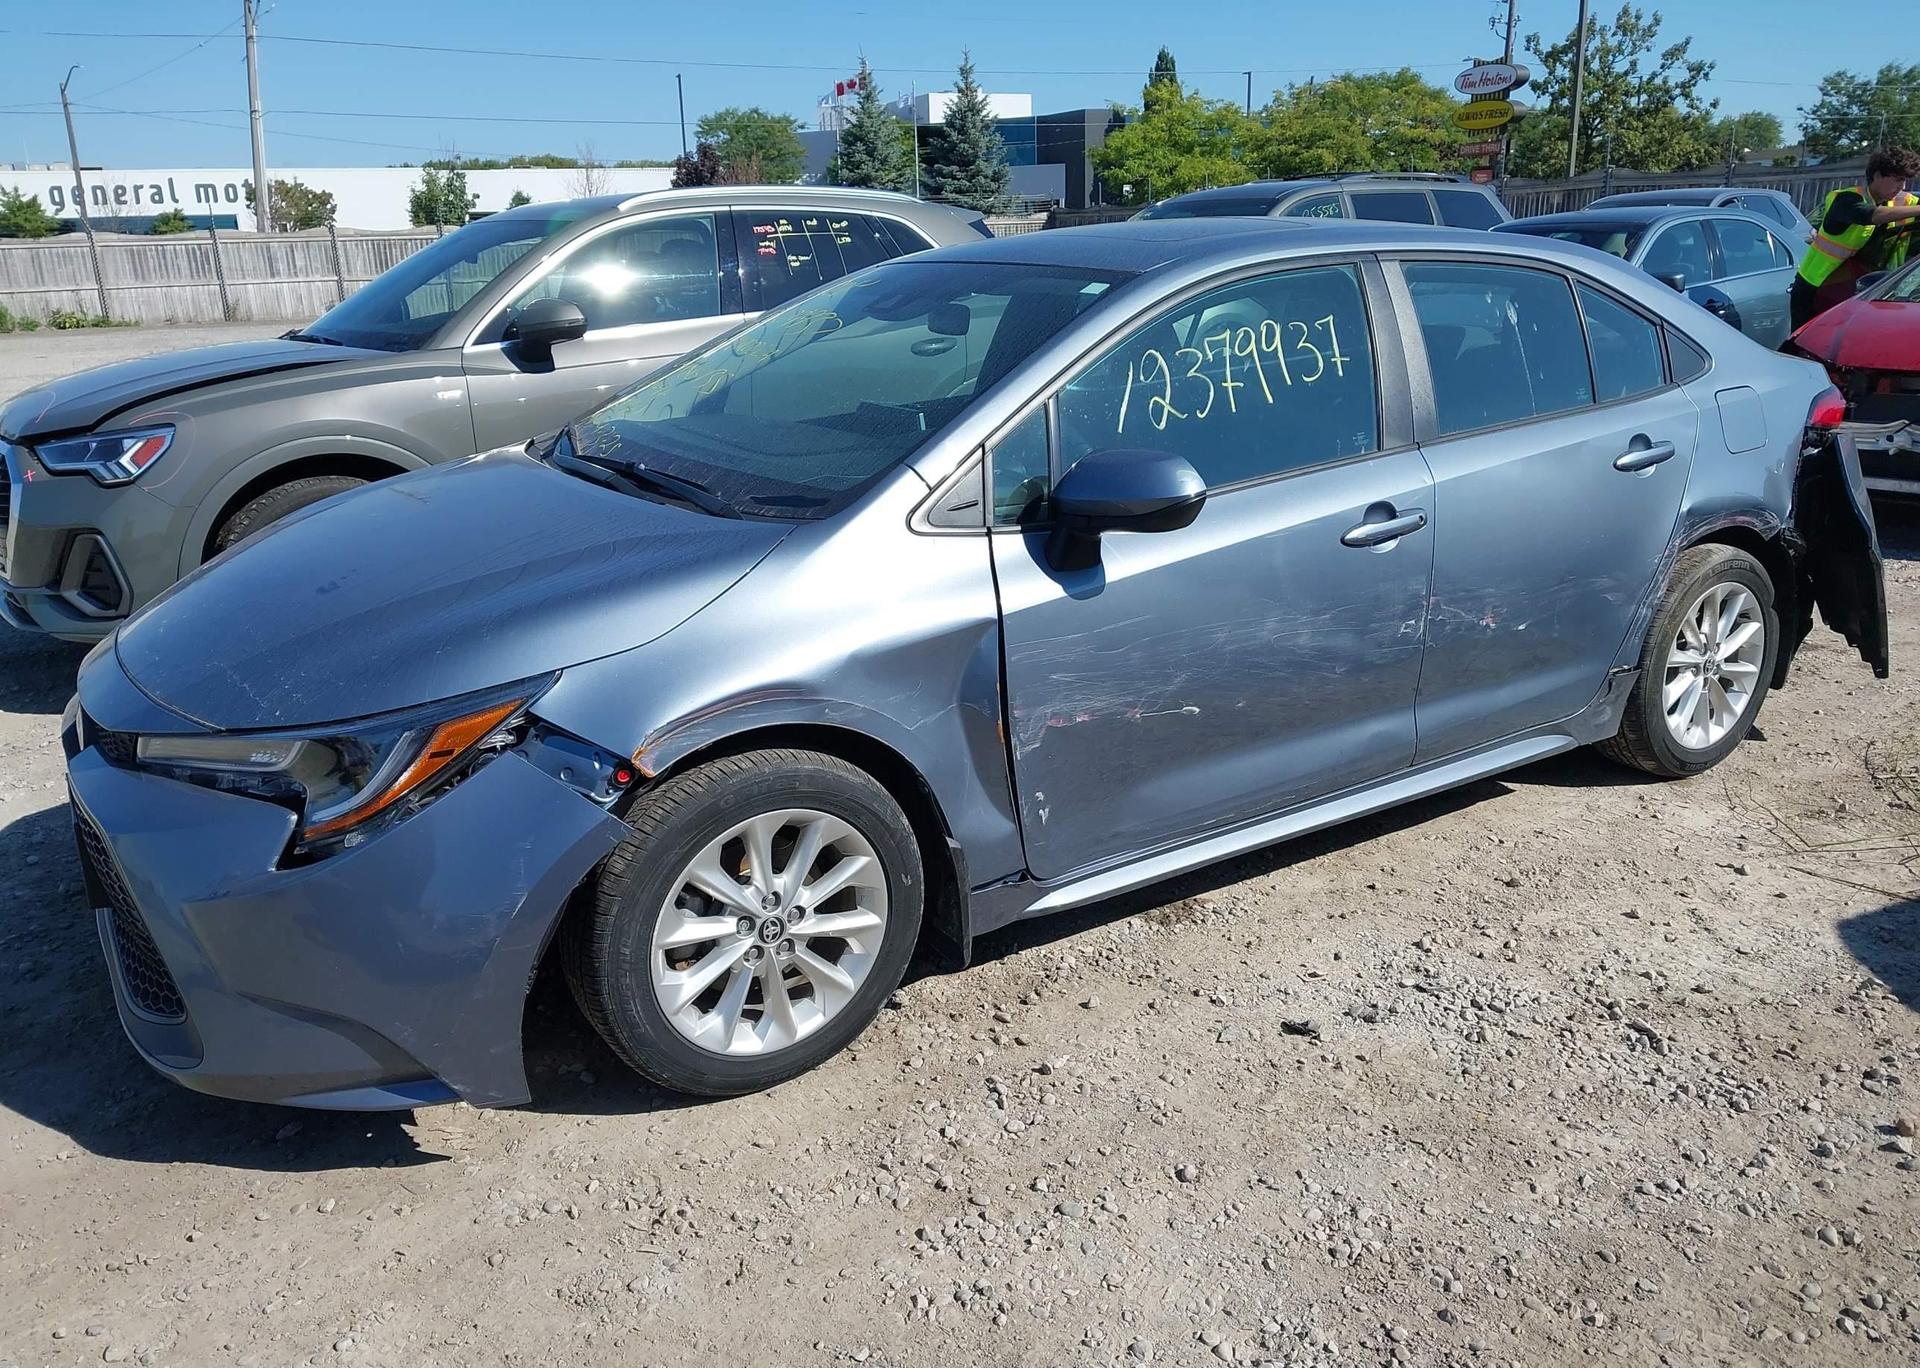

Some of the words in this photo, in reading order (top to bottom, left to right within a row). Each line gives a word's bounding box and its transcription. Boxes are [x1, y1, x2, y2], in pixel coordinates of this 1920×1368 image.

[1460, 73, 1477, 90] Tim
[1478, 71, 1512, 87] Hortons
[48, 177, 179, 215] general
[1117, 314, 1350, 433] 12379937
